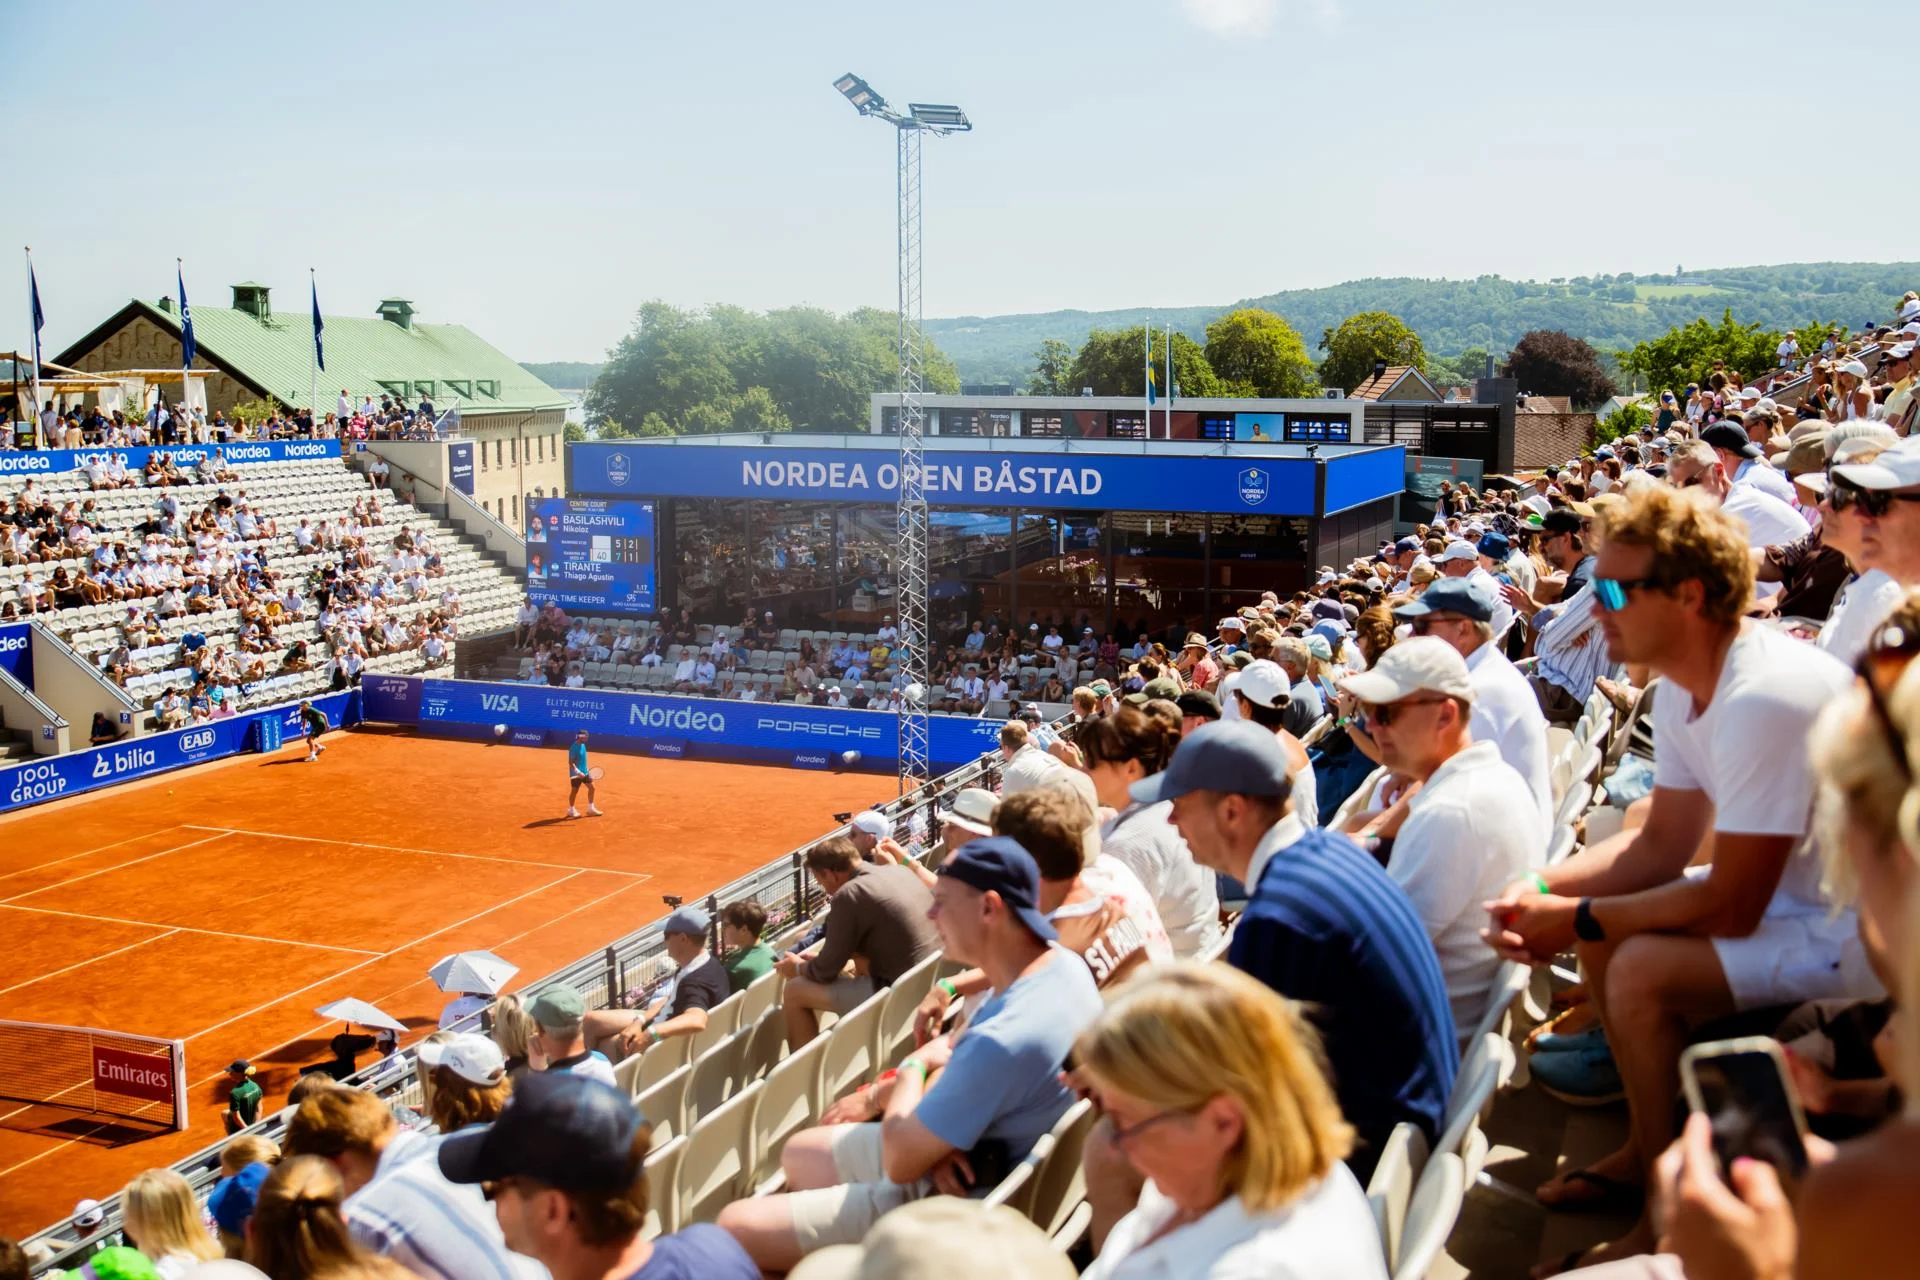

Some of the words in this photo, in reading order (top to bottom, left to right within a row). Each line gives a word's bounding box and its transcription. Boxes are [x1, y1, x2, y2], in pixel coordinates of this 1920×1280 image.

[226, 444, 271, 459] Nordea
[285, 443, 326, 457] Nordea
[0, 454, 50, 471] ordea
[743, 460, 869, 489] NORDEA
[877, 463, 963, 491] OPEN
[974, 460, 1102, 496] BÅSTAD
[563, 515, 625, 526] BASILASHVILI
[563, 525, 589, 533] Nikoloz
[615, 539, 621, 548] 5
[628, 540, 634, 549] 2
[597, 551, 607, 561] 40
[616, 552, 621, 560] 7
[564, 562, 601, 572] TIRANTE
[564, 571, 587, 581] Thiago
[530, 593, 559, 602] OFFICIAL
[560, 594, 577, 602] TIME
[579, 596, 606, 604] KEEPER
[376, 679, 408, 692] ATP
[480, 693, 519, 712] VISA
[546, 698, 569, 707] ELITE
[572, 700, 605, 710] HOTELS
[429, 706, 446, 716] 1:17
[562, 710, 598, 720] SWEDEN
[629, 703, 725, 733] Nordea
[757, 719, 881, 739] PORSCHE
[183, 730, 212, 750] EAB
[514, 732, 541, 741] Nordea
[653, 743, 681, 753] Nordea
[115, 748, 155, 773] bilia
[795, 754, 826, 765] Nordea
[17, 764, 59, 787] JOOL
[11, 777, 67, 802] GROUP
[97, 1059, 168, 1088] Emirates
